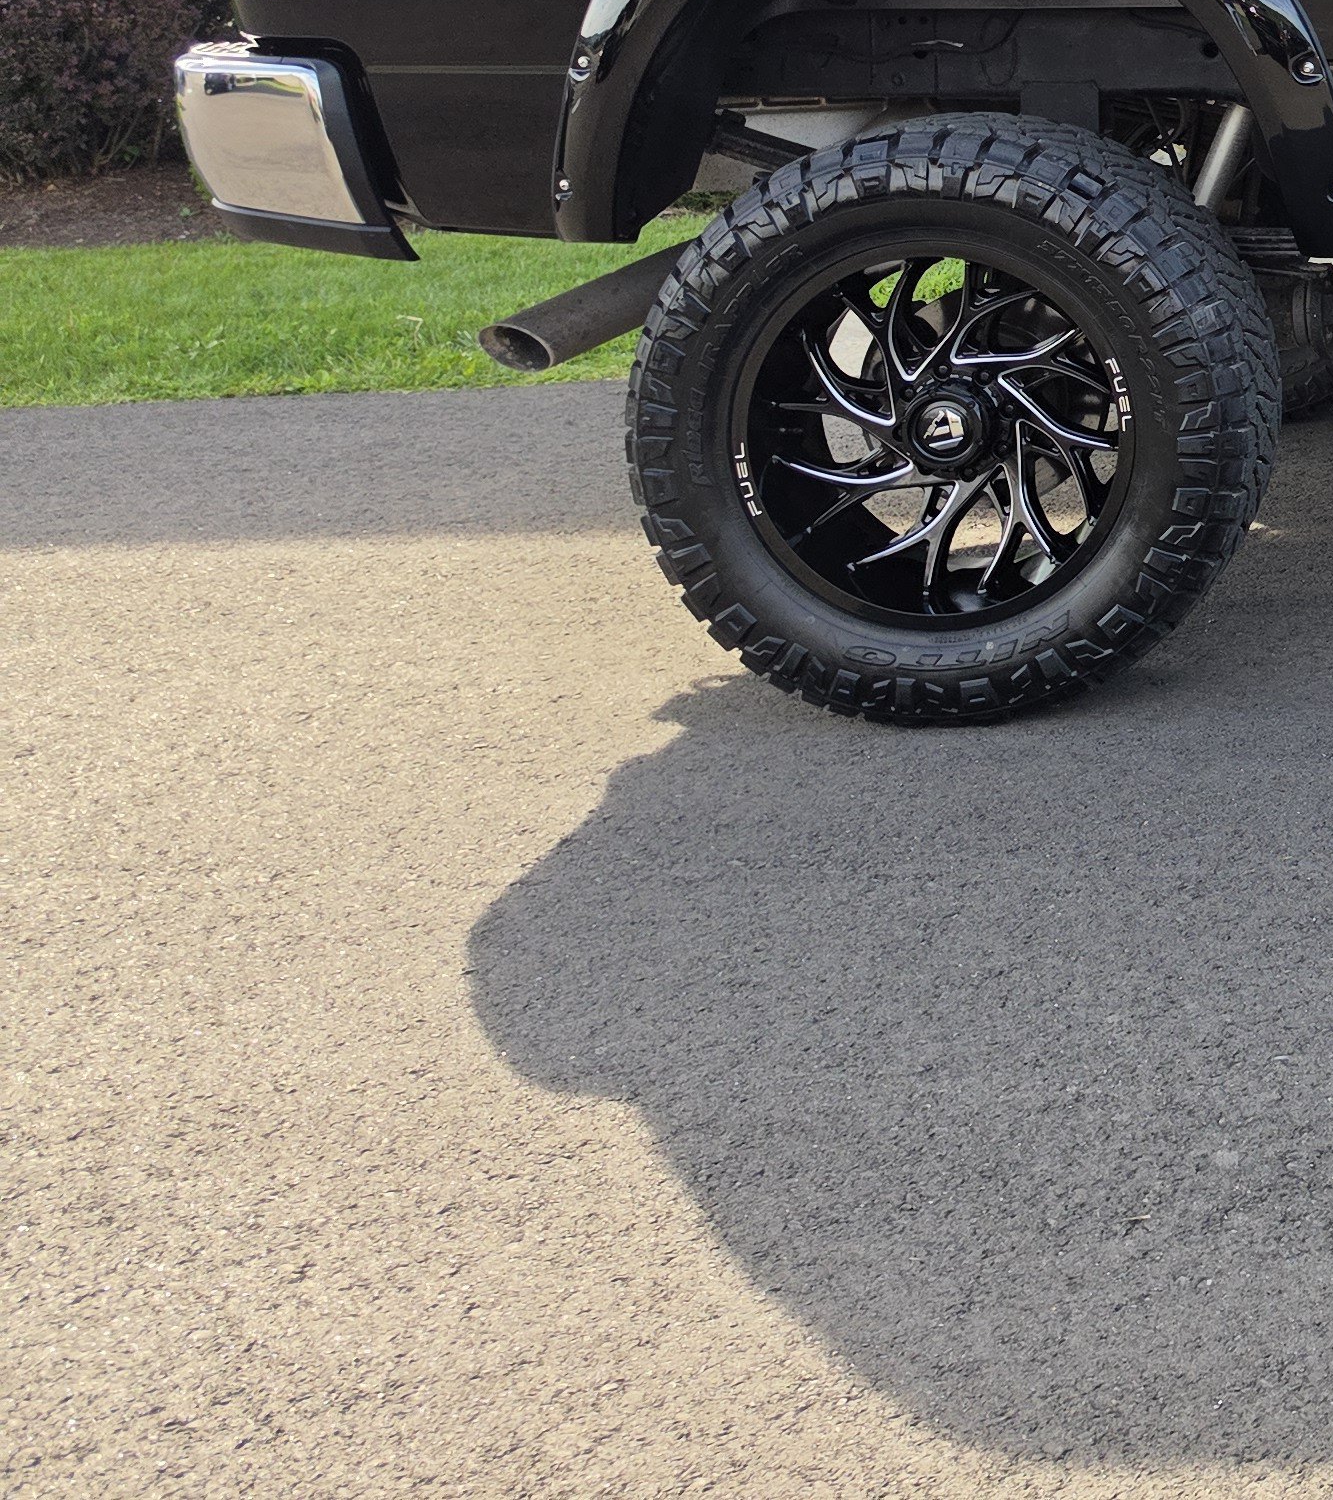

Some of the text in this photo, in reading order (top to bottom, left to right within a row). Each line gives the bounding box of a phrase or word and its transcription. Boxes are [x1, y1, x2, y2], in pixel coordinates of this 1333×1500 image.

[1104, 357, 1133, 432] FUEL
[733, 442, 763, 517] FUEL
[845, 609, 1071, 672] NITTO
